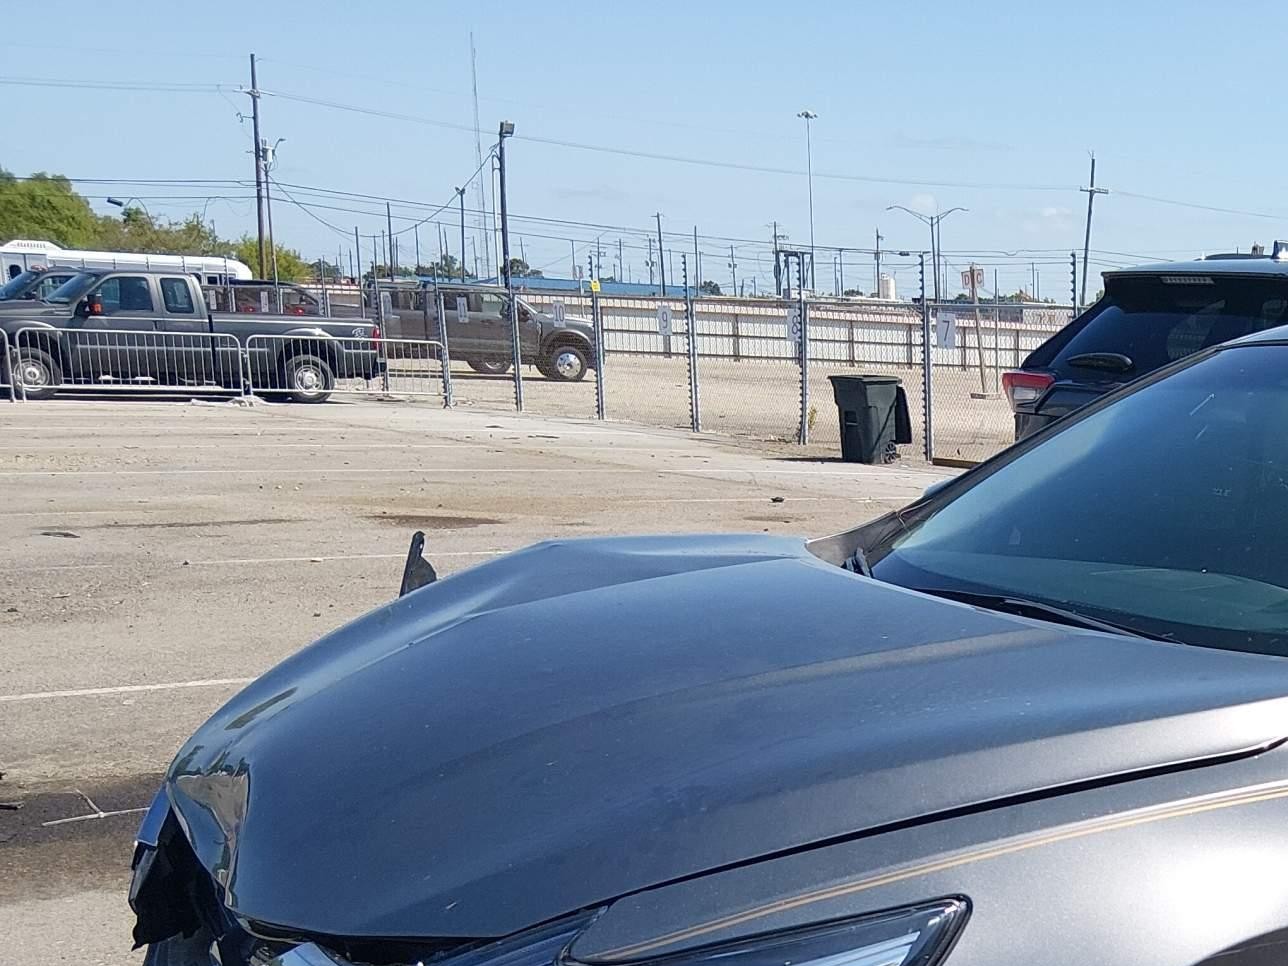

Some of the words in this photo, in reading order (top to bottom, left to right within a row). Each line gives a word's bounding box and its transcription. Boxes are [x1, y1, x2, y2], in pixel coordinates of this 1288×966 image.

[554, 304, 565, 322] 10
[661, 311, 668, 329] 9
[792, 315, 800, 335] 8
[942, 320, 950, 342] 7
